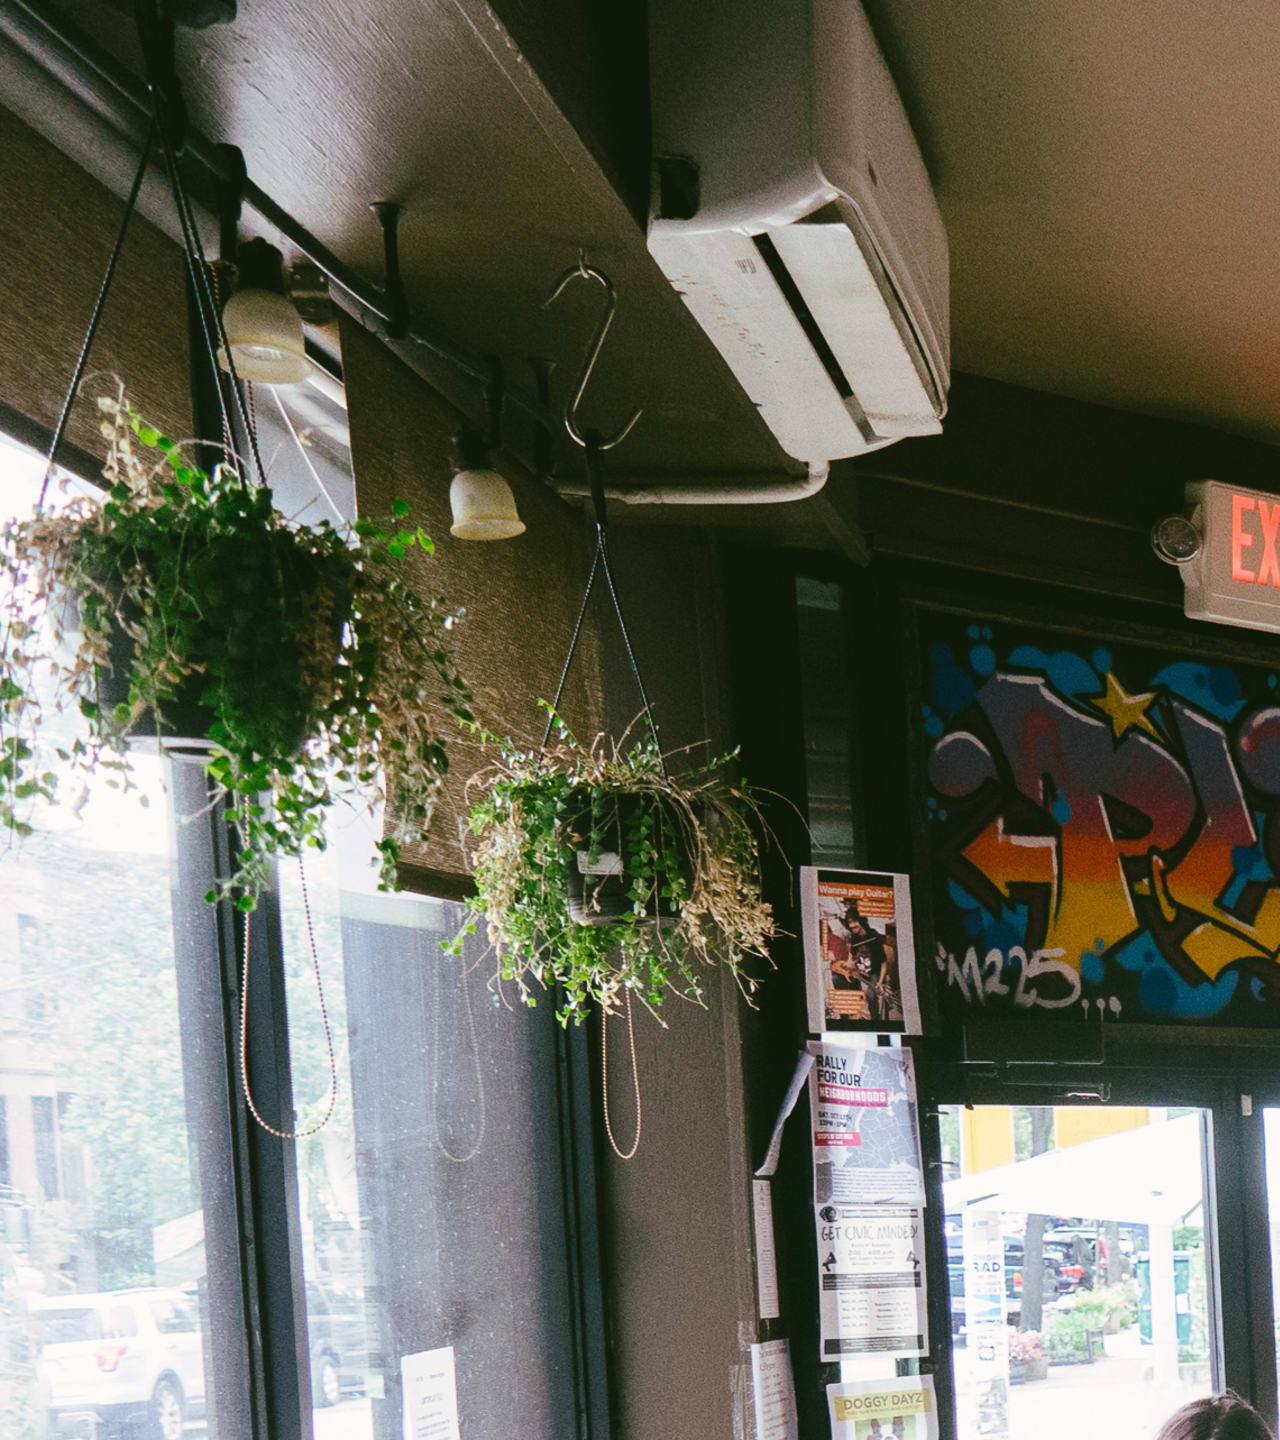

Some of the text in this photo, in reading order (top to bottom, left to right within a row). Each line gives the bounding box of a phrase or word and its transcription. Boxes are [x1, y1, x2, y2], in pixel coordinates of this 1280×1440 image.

[818, 884, 894, 899] Wanna play Guitar?
[815, 1054, 847, 1071] RALLY
[816, 1069, 862, 1087] FOR OUR
[821, 1224, 841, 1241] GET
[844, 1224, 873, 1241] CIVIC
[844, 1392, 923, 1410] DOGGY DAYZ
